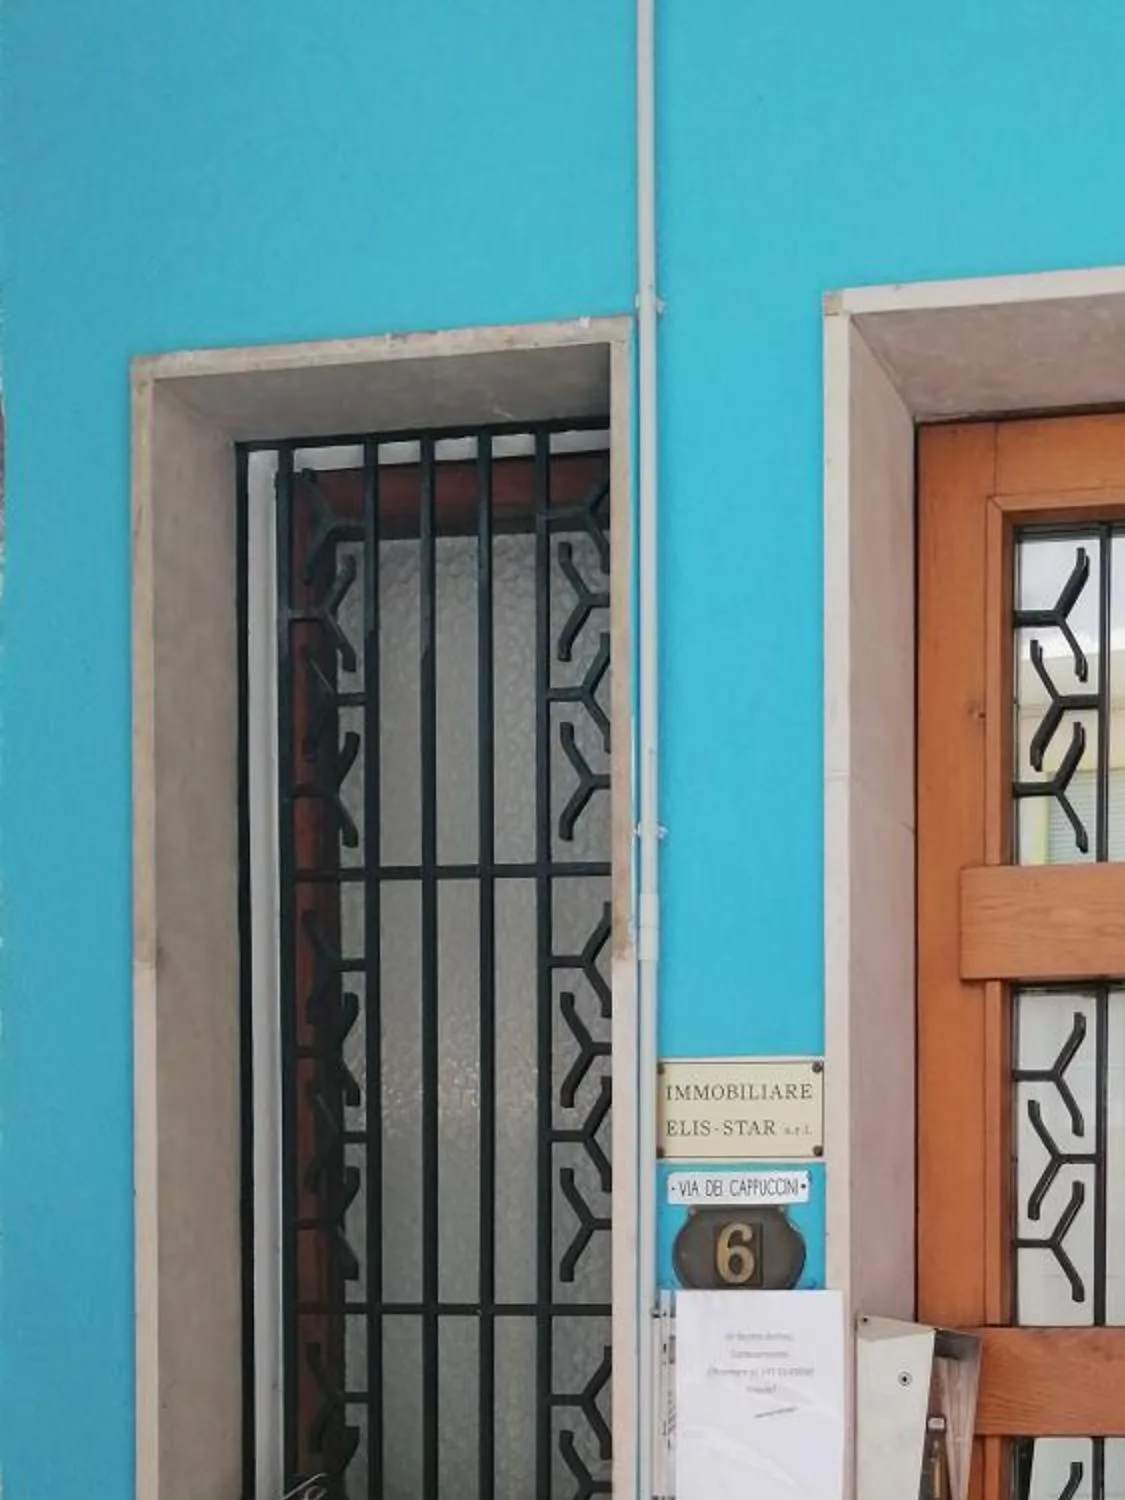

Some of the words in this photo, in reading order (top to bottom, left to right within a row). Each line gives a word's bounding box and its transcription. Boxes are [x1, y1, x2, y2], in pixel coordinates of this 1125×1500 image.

[667, 1084, 812, 1100] IMMOBILIARE
[667, 1120, 776, 1137] ELIS-STAR
[679, 1180, 699, 1196] VIA
[729, 1178, 798, 1196] CAPPUCCINI
[717, 1223, 755, 1284] 6
